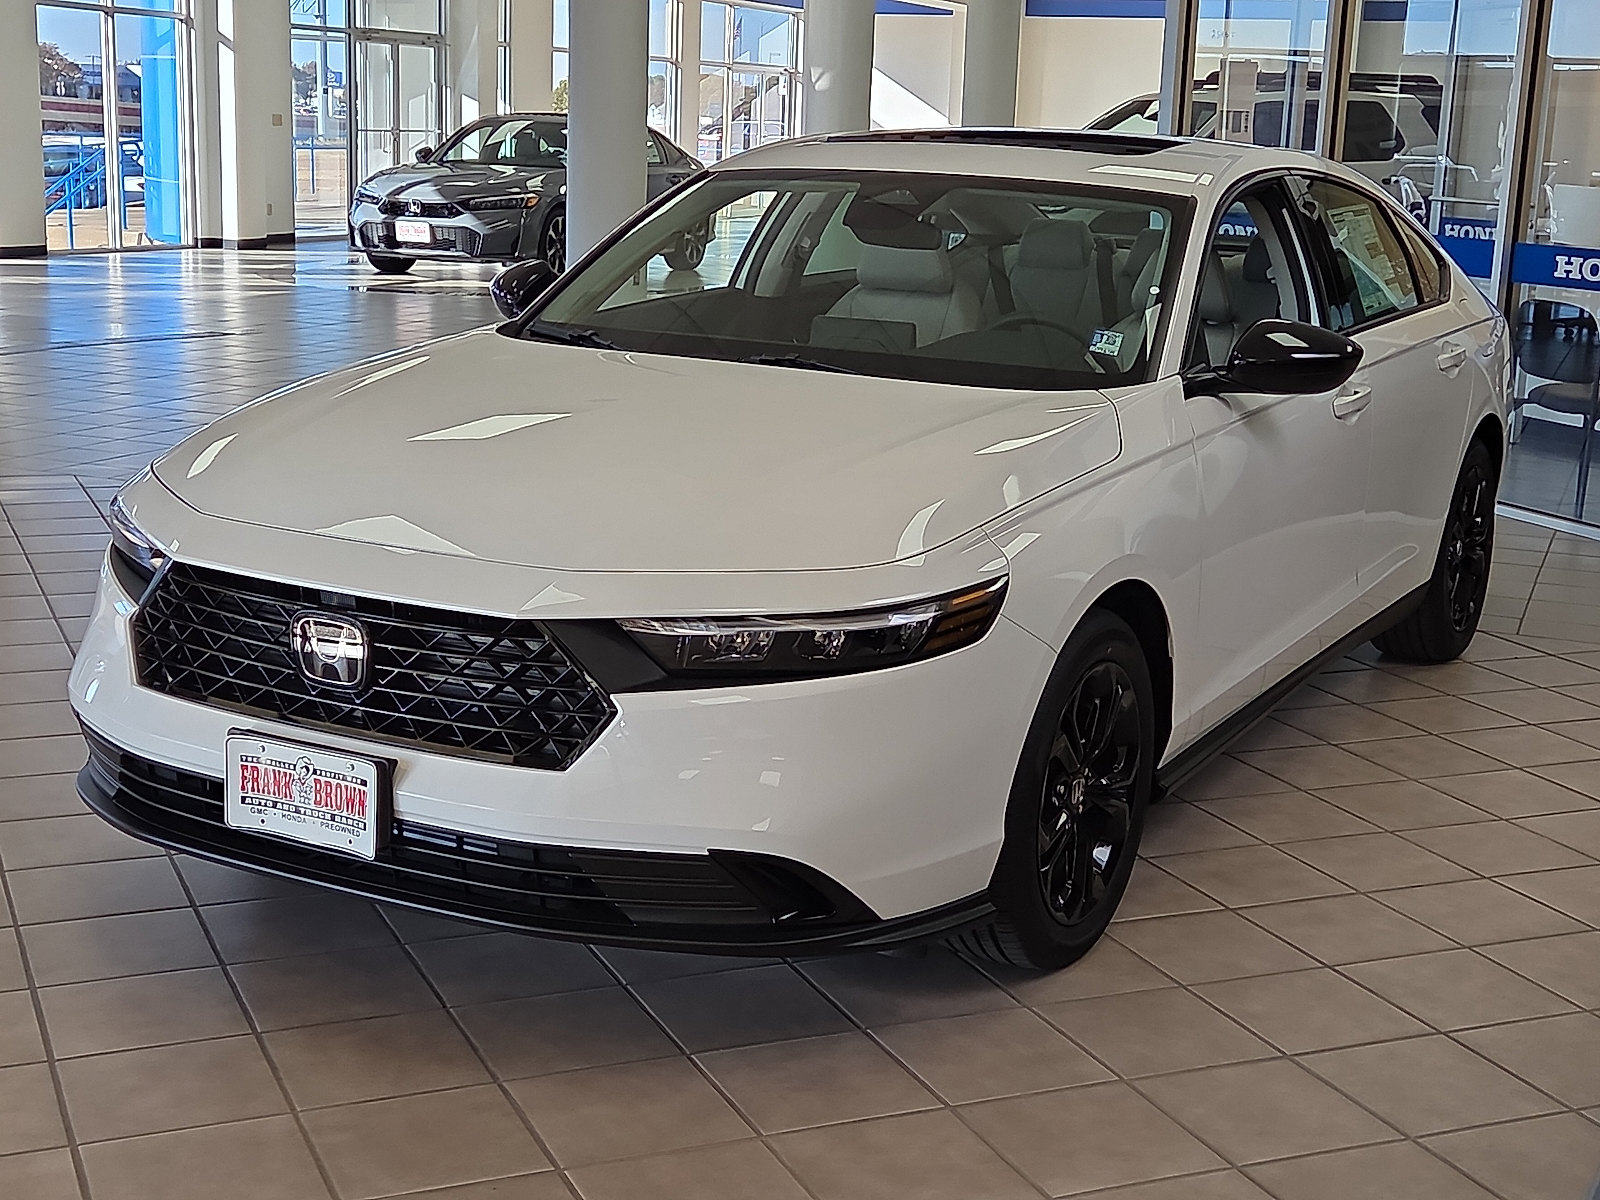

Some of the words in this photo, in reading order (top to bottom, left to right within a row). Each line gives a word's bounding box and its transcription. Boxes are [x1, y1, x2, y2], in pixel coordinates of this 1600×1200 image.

[240, 764, 294, 800] FRANK
[313, 778, 366, 818] BROWN
[244, 797, 273, 808] AUTO
[275, 802, 296, 812] AND
[298, 807, 332, 820] TRUCK
[334, 815, 365, 830] RANCH
[250, 806, 268, 816] GMC
[281, 813, 307, 824] HONDA
[320, 821, 361, 837] PREOWNED
